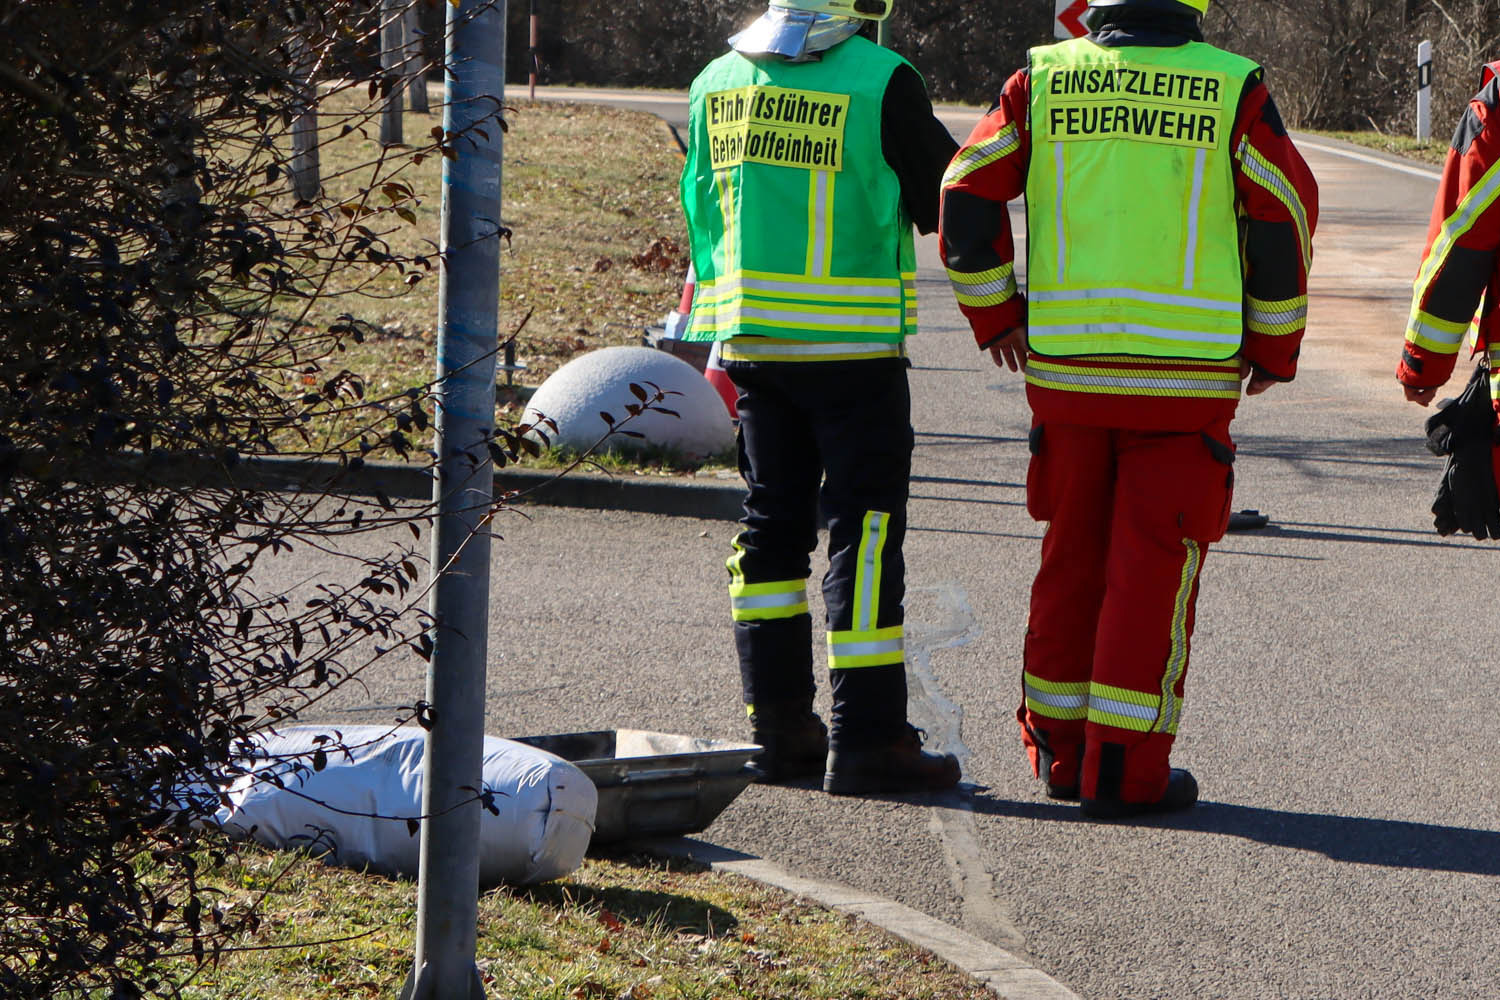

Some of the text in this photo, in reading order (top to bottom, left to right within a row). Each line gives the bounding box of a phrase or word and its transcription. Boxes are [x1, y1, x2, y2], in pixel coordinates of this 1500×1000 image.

[1050, 69, 1220, 102] EINSATZLEITER
[711, 90, 843, 127] Einhitsführer
[1050, 105, 1216, 143] FEUERWEHR
